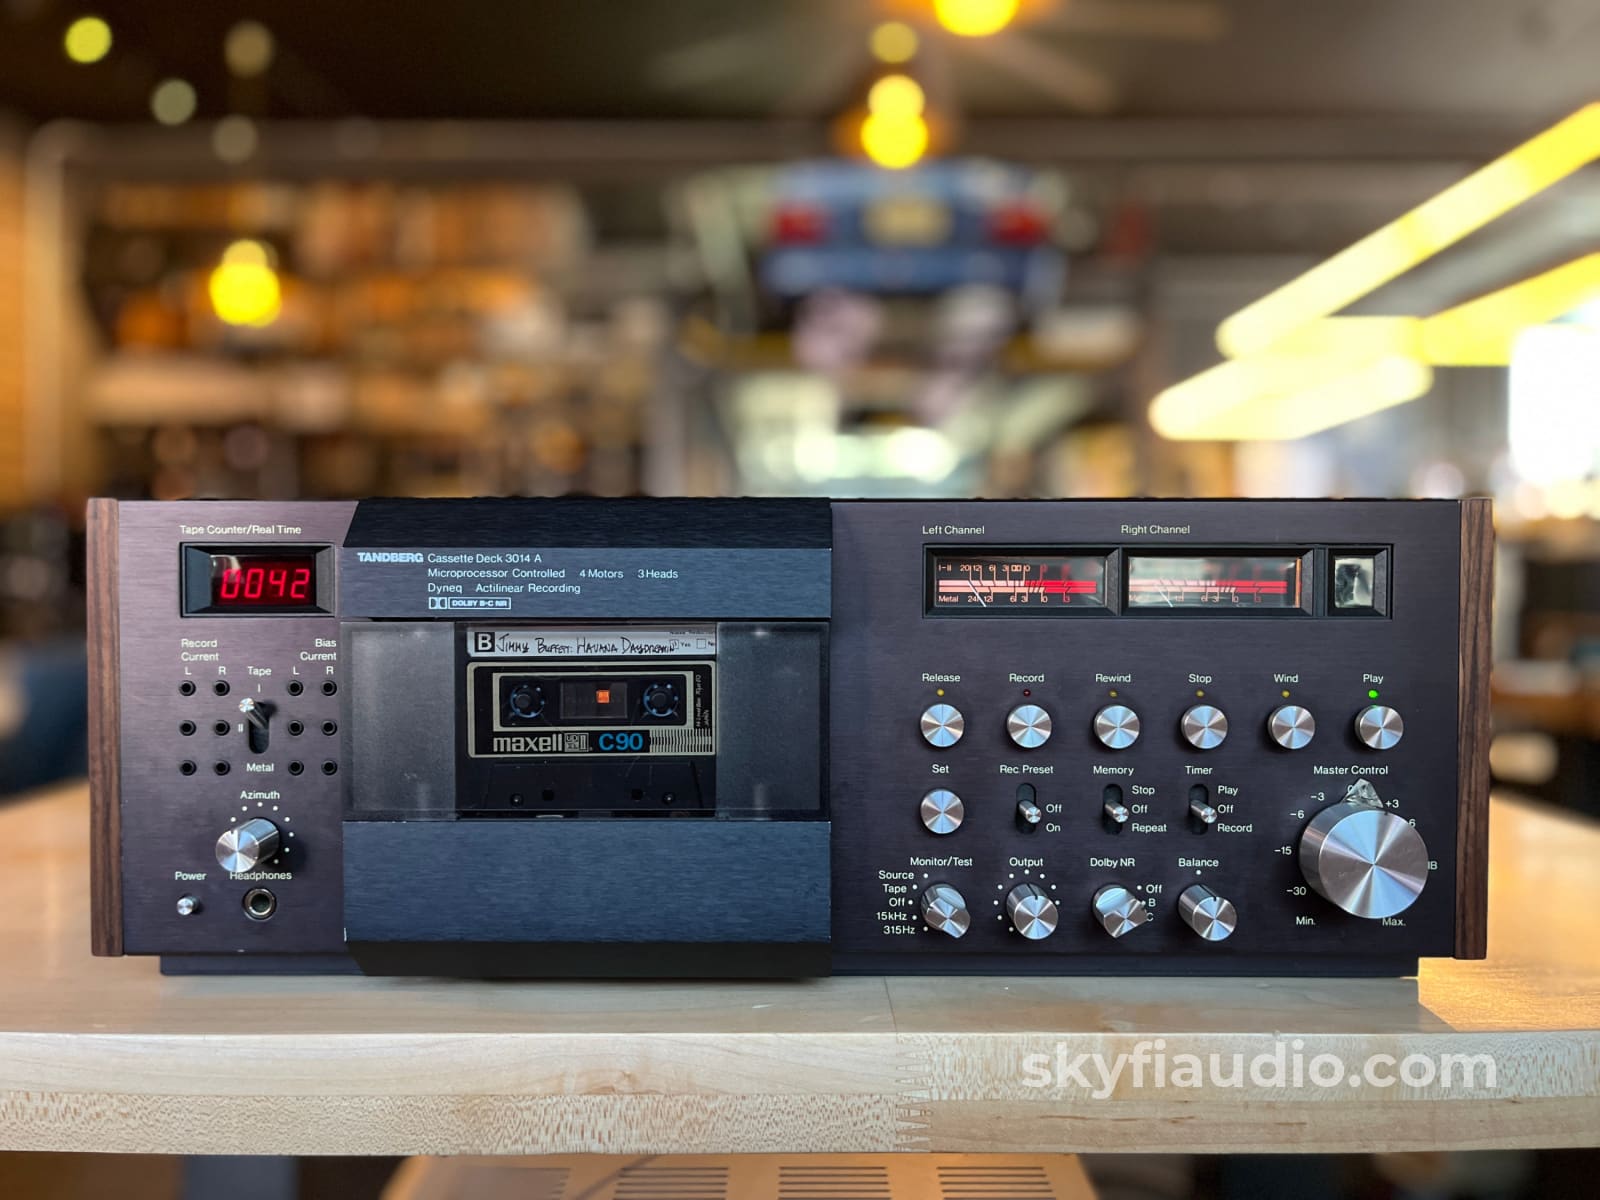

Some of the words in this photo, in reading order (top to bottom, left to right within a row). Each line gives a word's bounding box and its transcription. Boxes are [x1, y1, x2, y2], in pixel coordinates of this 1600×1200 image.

[180, 525, 204, 535] Tape
[207, 525, 275, 534] Counter/Real
[278, 525, 301, 534] Time
[922, 526, 942, 535] Left
[944, 526, 985, 535] Channel
[1121, 525, 1147, 536] Right
[1149, 525, 1190, 534] Channel
[357, 552, 424, 563] TANDBERG
[427, 553, 473, 563] Cassette
[476, 553, 503, 563] Deck
[505, 553, 531, 563] 3014
[534, 553, 542, 563] A
[427, 568, 508, 580] Microprocessor
[512, 568, 565, 579] Controlled
[220, 568, 310, 599] 0042
[428, 583, 462, 595] Dyneq
[476, 583, 524, 593] Actilinear
[528, 583, 581, 594] Recording
[939, 595, 959, 603] Metal
[181, 639, 218, 648] Record
[315, 638, 337, 647] Bias
[477, 632, 493, 650] B
[496, 633, 530, 652] JIMMY
[181, 652, 219, 661] Current
[300, 651, 337, 661] Current
[184, 666, 192, 675] L
[219, 666, 226, 675] R
[247, 666, 272, 676] Tape
[293, 666, 300, 675] L
[326, 666, 334, 675] R
[922, 673, 961, 682] Release
[1009, 673, 1045, 682] Record
[1095, 673, 1131, 682] Rewind
[1188, 674, 1212, 683] Stop
[1274, 674, 1299, 683] Wind
[1363, 674, 1384, 684] Play
[493, 733, 562, 752] maxell
[599, 733, 643, 750] C90
[246, 763, 274, 772] Metal
[932, 764, 949, 774] Set
[1000, 765, 1019, 774] Rec
[1022, 765, 1054, 774] Preset
[1093, 766, 1135, 777] Memory
[1185, 766, 1213, 775] Timer
[1313, 766, 1348, 775] Master
[1351, 766, 1389, 775] Control
[1131, 785, 1155, 795] Stop
[1217, 786, 1239, 796] Play
[240, 791, 280, 800] Azimuth
[1046, 804, 1062, 813] Off
[1385, 800, 1399, 808] +3
[1131, 805, 1148, 814] Off
[1217, 805, 1234, 814] Off
[1046, 824, 1061, 832] On
[1131, 824, 1167, 834] Repeat
[1217, 824, 1252, 833] Record
[910, 856, 973, 866] Monitor/Test
[1009, 857, 1043, 868] Output
[1090, 858, 1118, 868] Dolby
[1120, 858, 1135, 867] NR
[1178, 858, 1219, 867] Balance
[175, 871, 207, 880] Power
[229, 871, 292, 881] Headphones
[879, 870, 914, 879] Source
[883, 884, 907, 893] Tape
[1146, 884, 1162, 893] Off
[889, 897, 905, 907] Off
[1148, 899, 1156, 907] B
[876, 911, 907, 921] 15kHz
[1296, 917, 1316, 925] Min.
[1382, 917, 1406, 926] Max.
[883, 925, 915, 934] 315Hz
